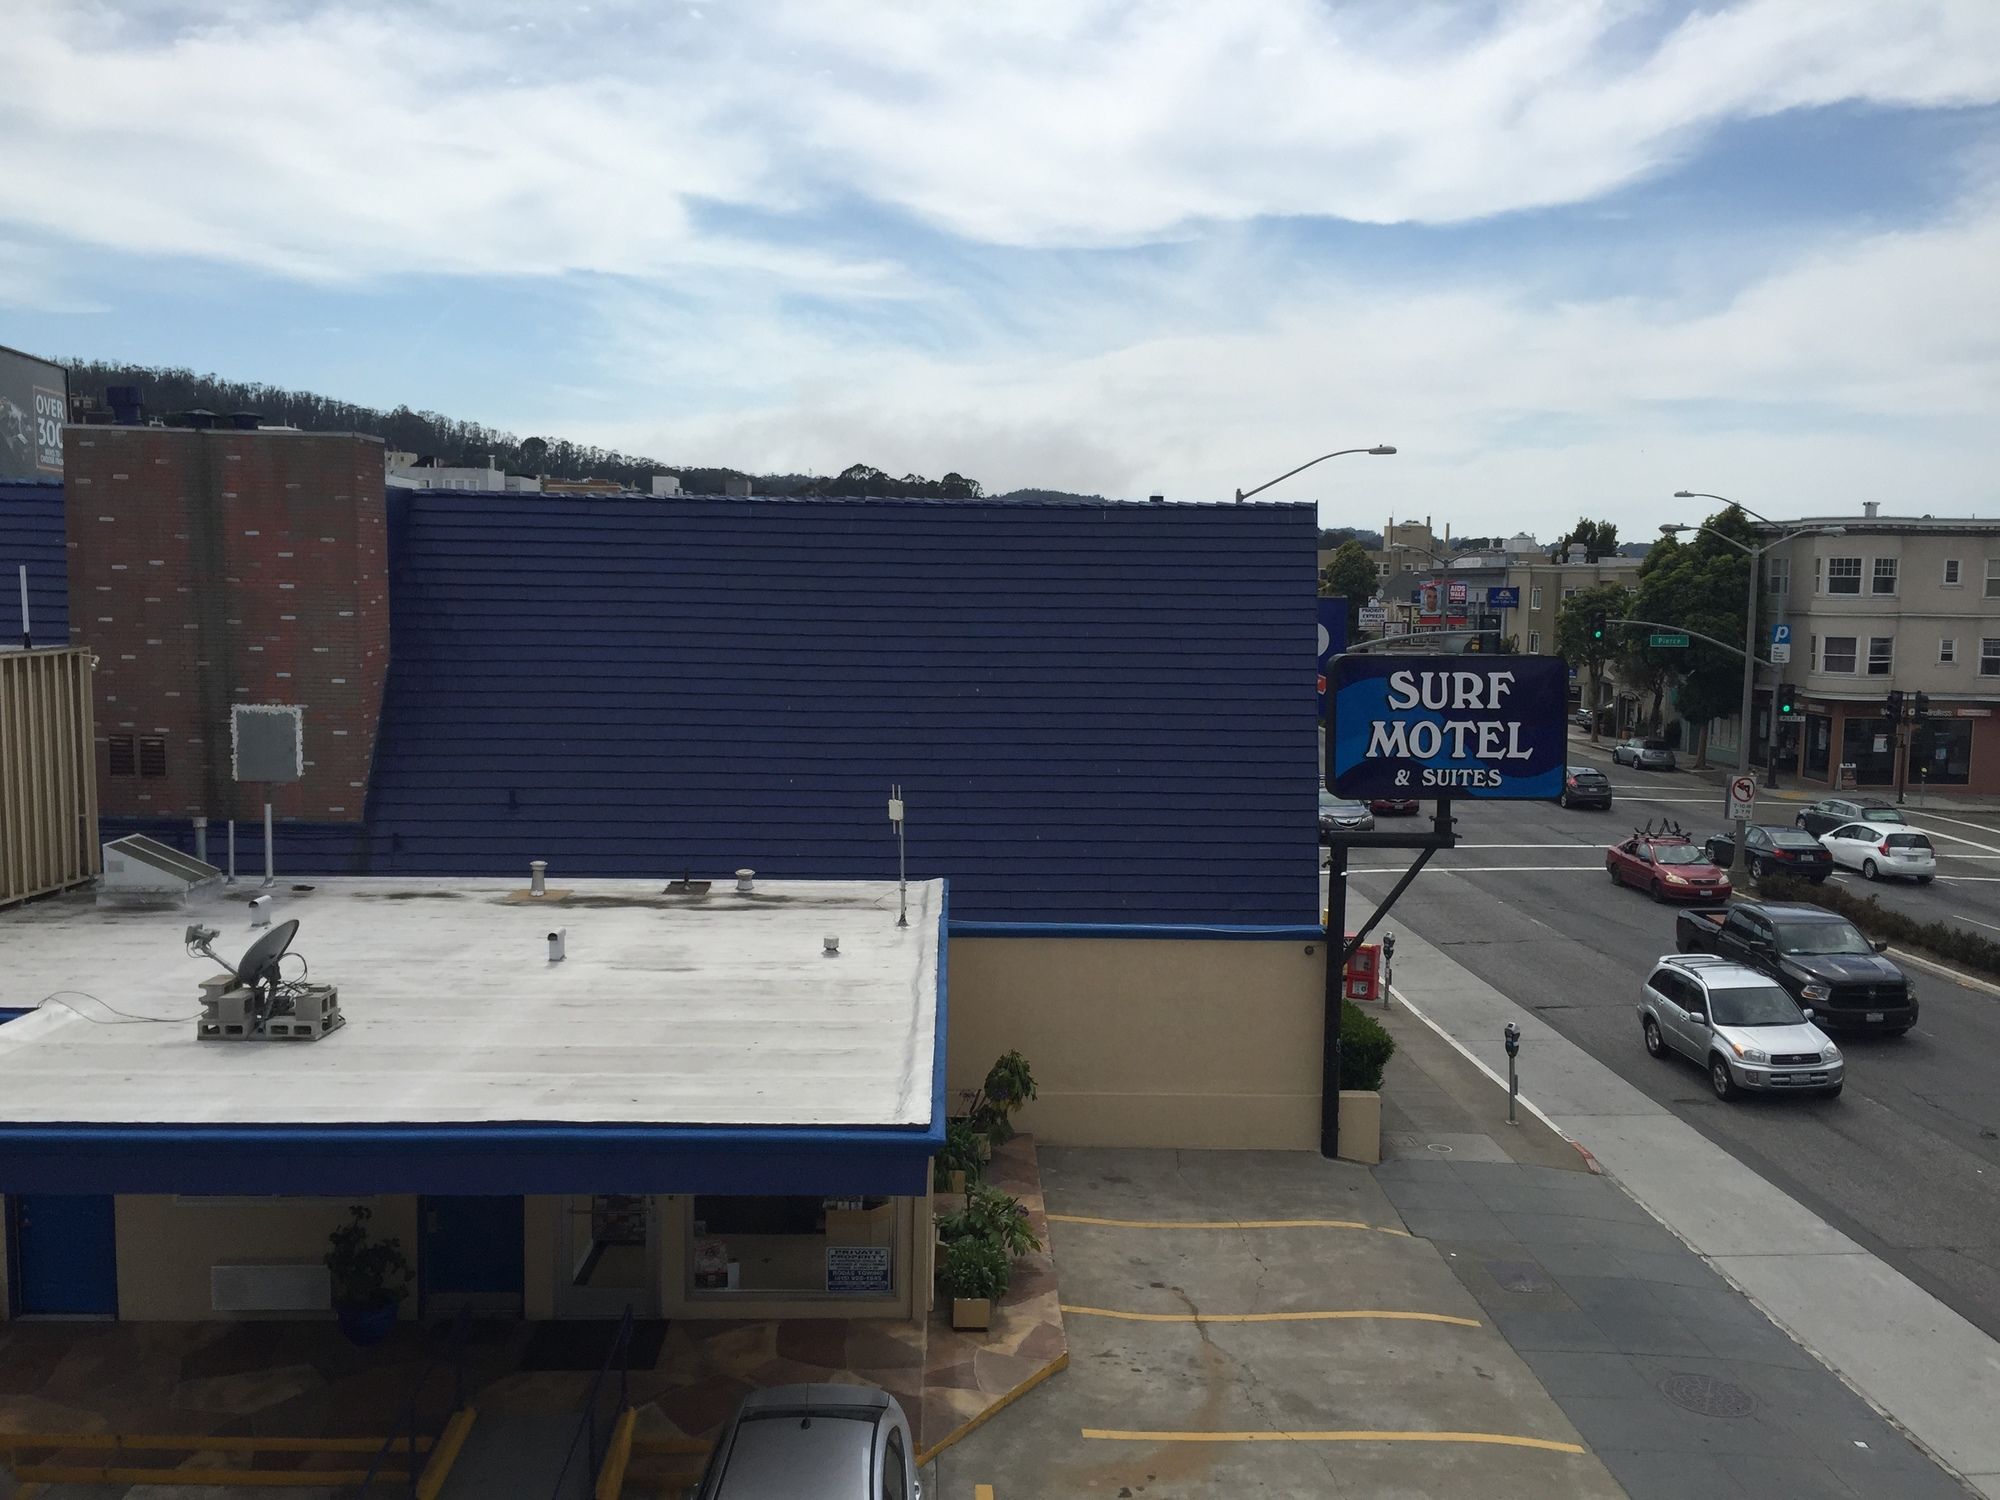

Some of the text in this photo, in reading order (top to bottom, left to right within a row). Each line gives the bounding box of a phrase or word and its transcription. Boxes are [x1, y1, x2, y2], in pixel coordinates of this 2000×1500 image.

[36, 394, 64, 419] OVER
[1658, 637, 1681, 645] Pierce
[1387, 670, 1516, 711] SURF
[1365, 720, 1534, 760] MOTEL
[1394, 768, 1502, 787] & SUITES
